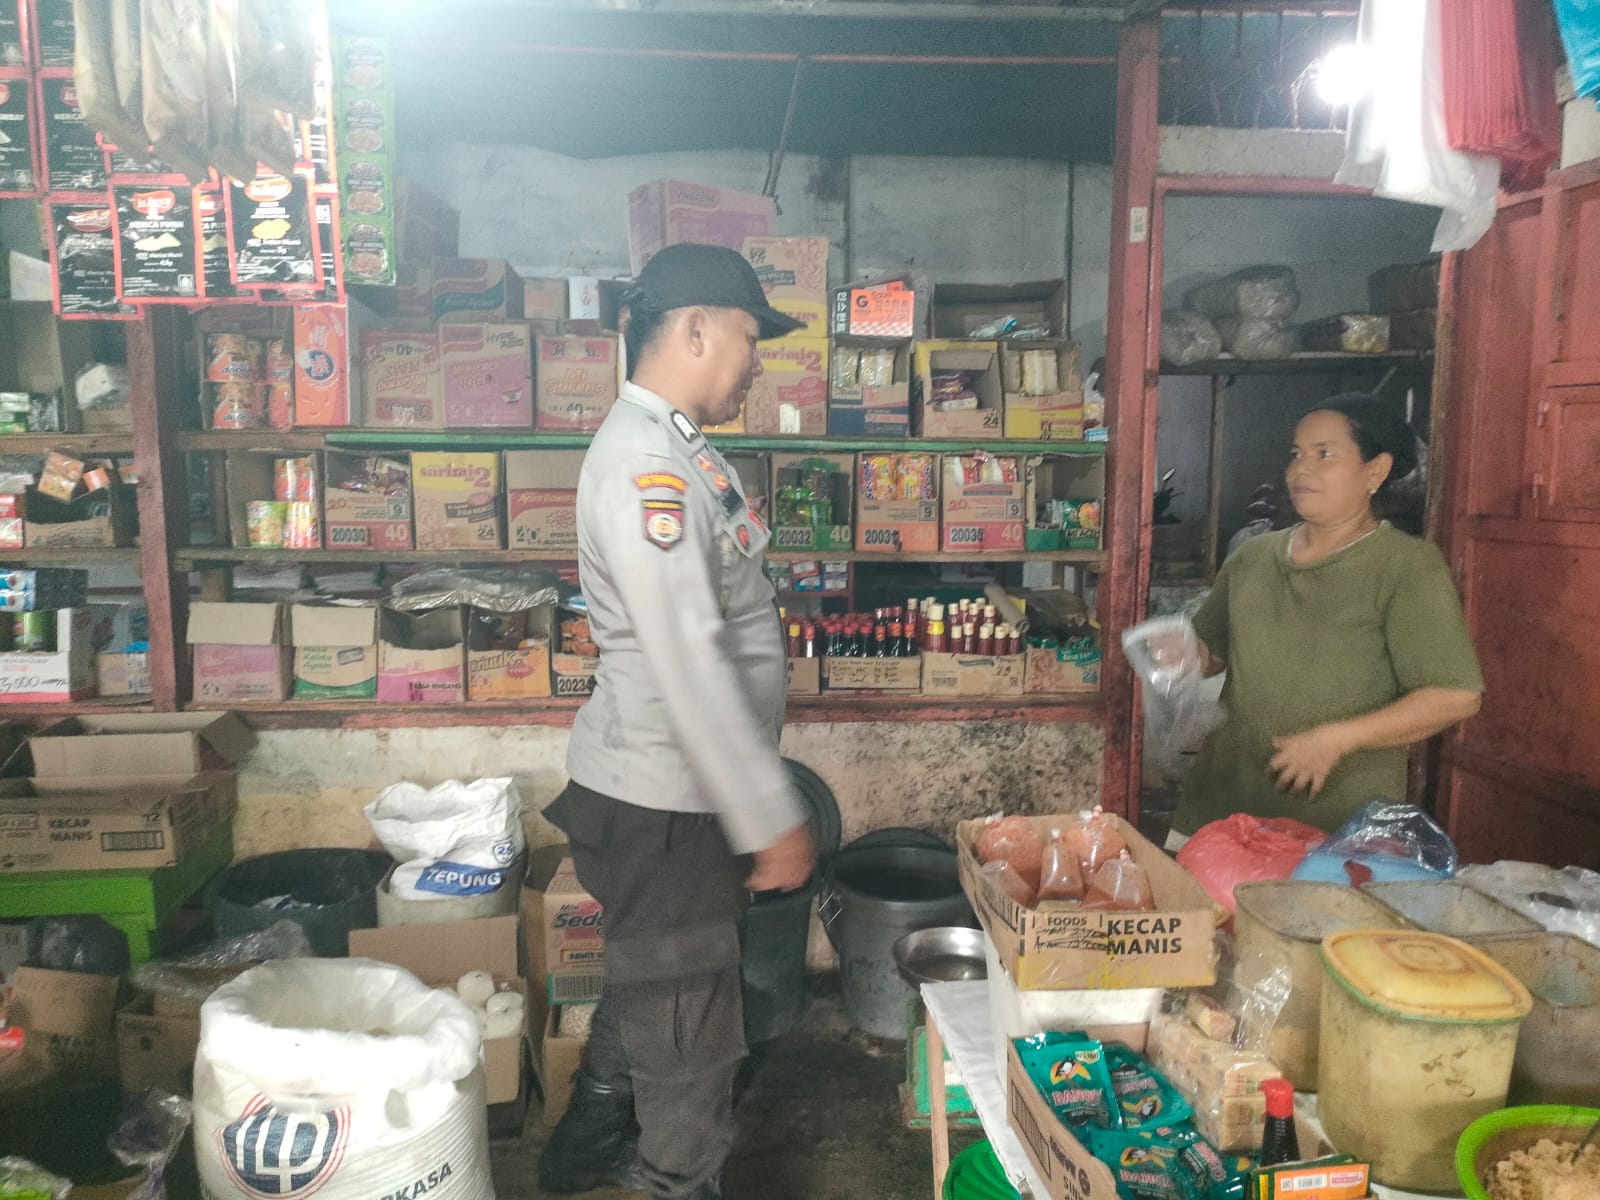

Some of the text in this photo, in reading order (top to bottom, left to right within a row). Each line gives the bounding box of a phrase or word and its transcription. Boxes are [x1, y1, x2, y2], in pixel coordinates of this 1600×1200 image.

[777, 529, 812, 545] 20032
[49, 817, 91, 829] KECAP
[50, 830, 94, 842] MANIS
[426, 868, 502, 889] TEPUNG
[1047, 916, 1183, 936] FOODS KECAP
[1106, 937, 1183, 956] MANIS
